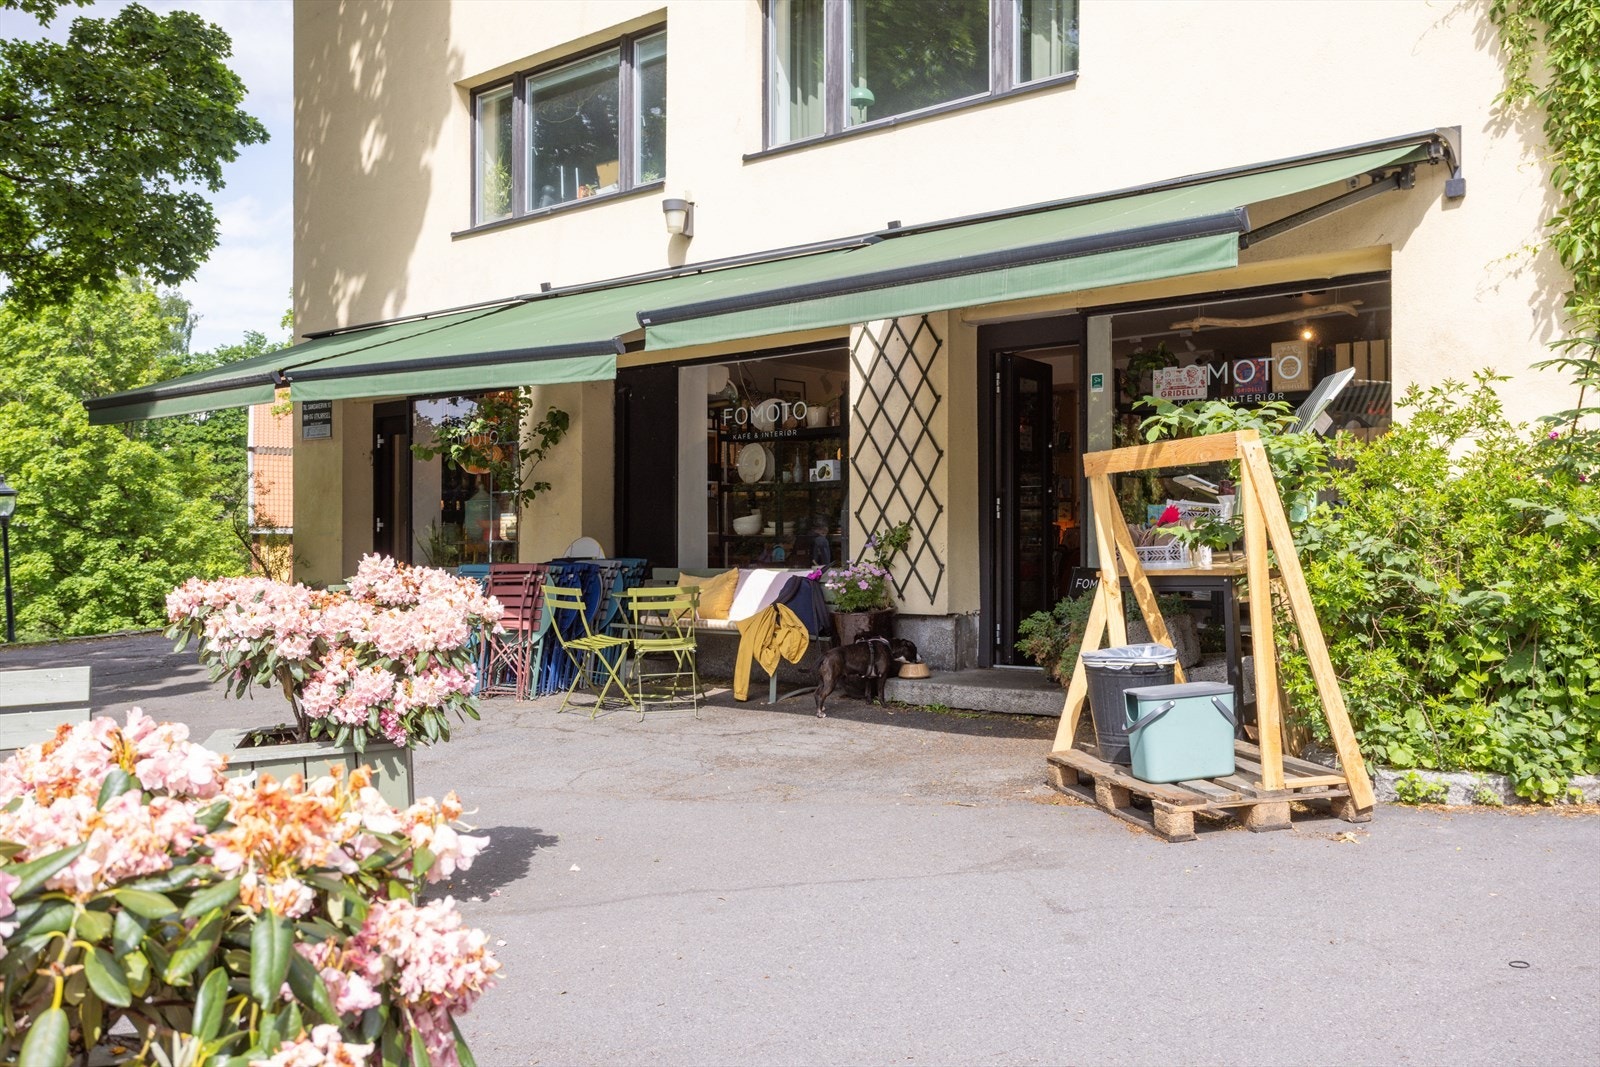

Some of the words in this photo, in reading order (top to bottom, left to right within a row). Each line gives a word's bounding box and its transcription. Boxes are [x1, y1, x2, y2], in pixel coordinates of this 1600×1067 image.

[1161, 389, 1198, 398] GRIDELLI
[1236, 386, 1263, 394] GRIDELLI
[1226, 392, 1285, 403] INTERIØR
[724, 402, 807, 426] FOMOTO
[450, 430, 499, 447] OMOTO
[761, 429, 797, 438] INTERIØR
[1075, 578, 1098, 589] FOM
